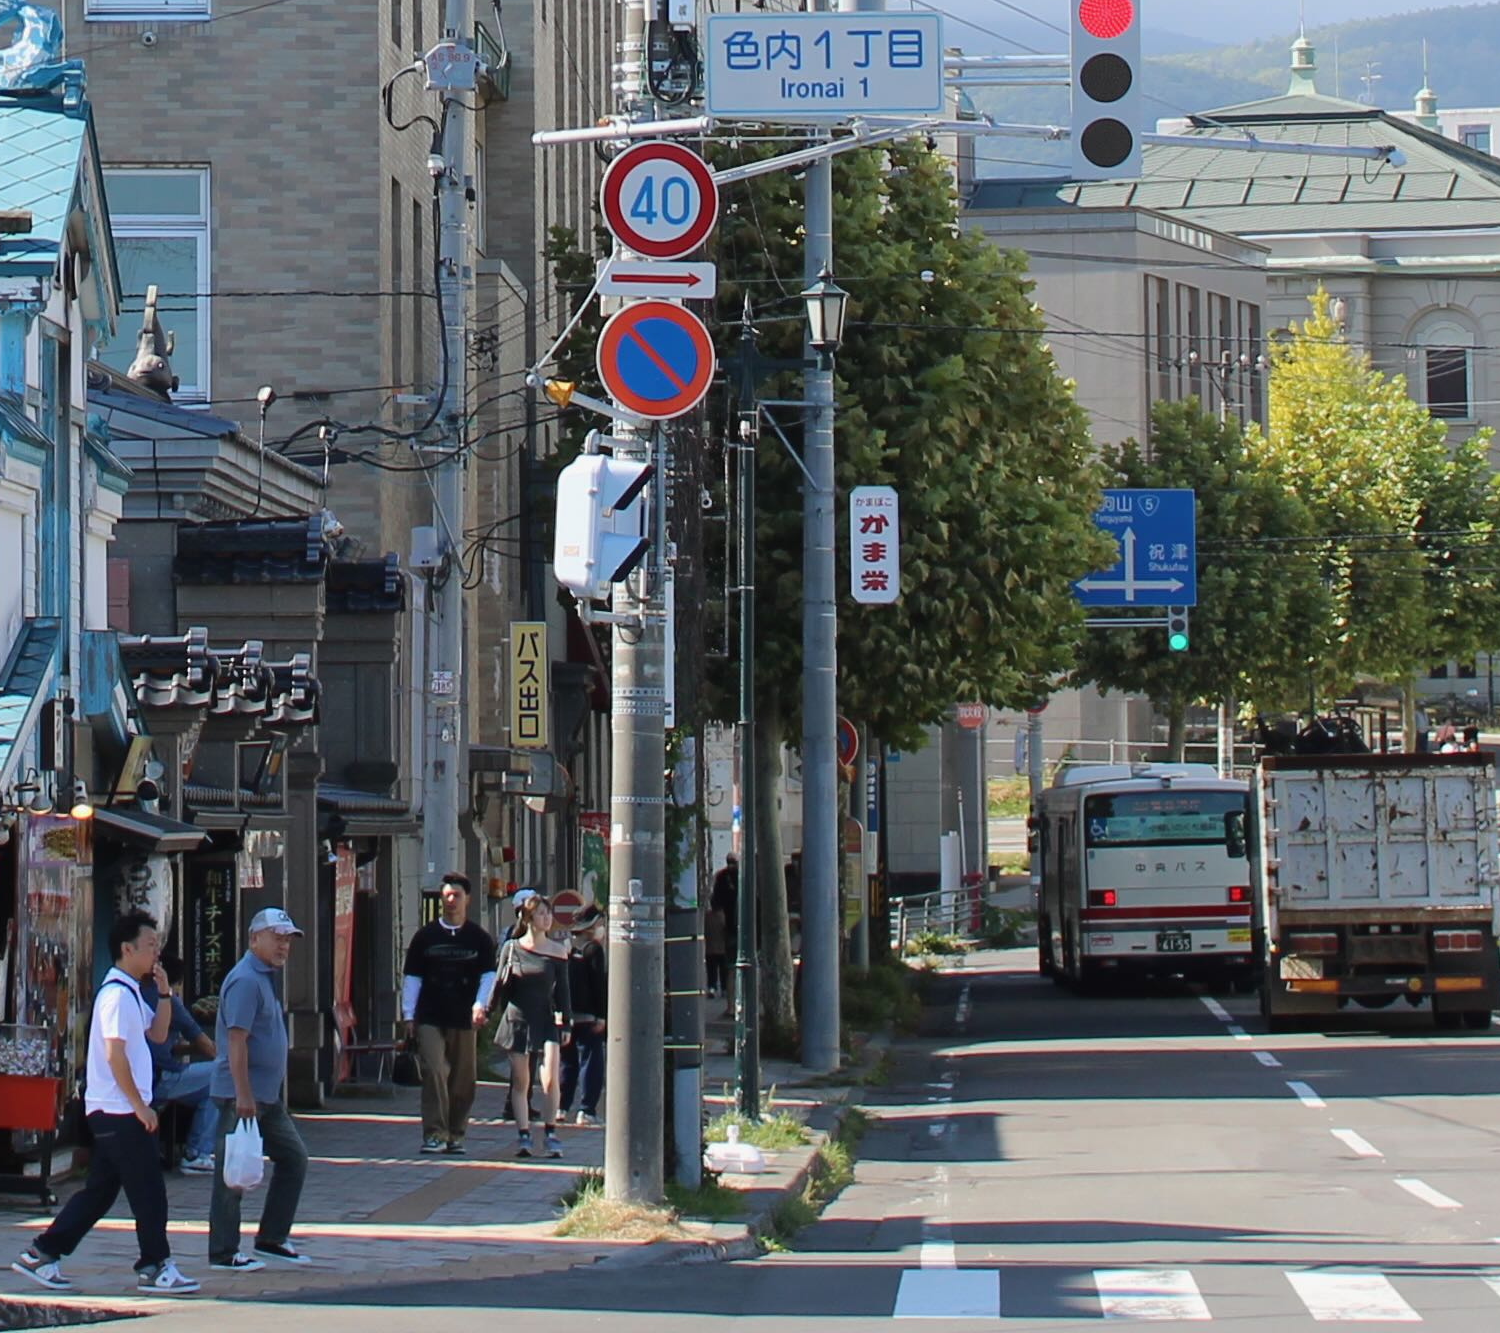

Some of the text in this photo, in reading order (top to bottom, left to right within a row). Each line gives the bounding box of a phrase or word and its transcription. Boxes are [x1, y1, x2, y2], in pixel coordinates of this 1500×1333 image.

[723, 29, 922, 70] 色内1丁目
[781, 77, 868, 99] Ironai 1
[630, 175, 690, 225] 40
[855, 497, 893, 507] かまぼこ
[1144, 498, 1154, 511] 5
[860, 514, 889, 592] かま栄
[1149, 544, 1188, 560] 祝津
[517, 632, 540, 738] バス出口
[1135, 861, 1207, 872] 中央バス
